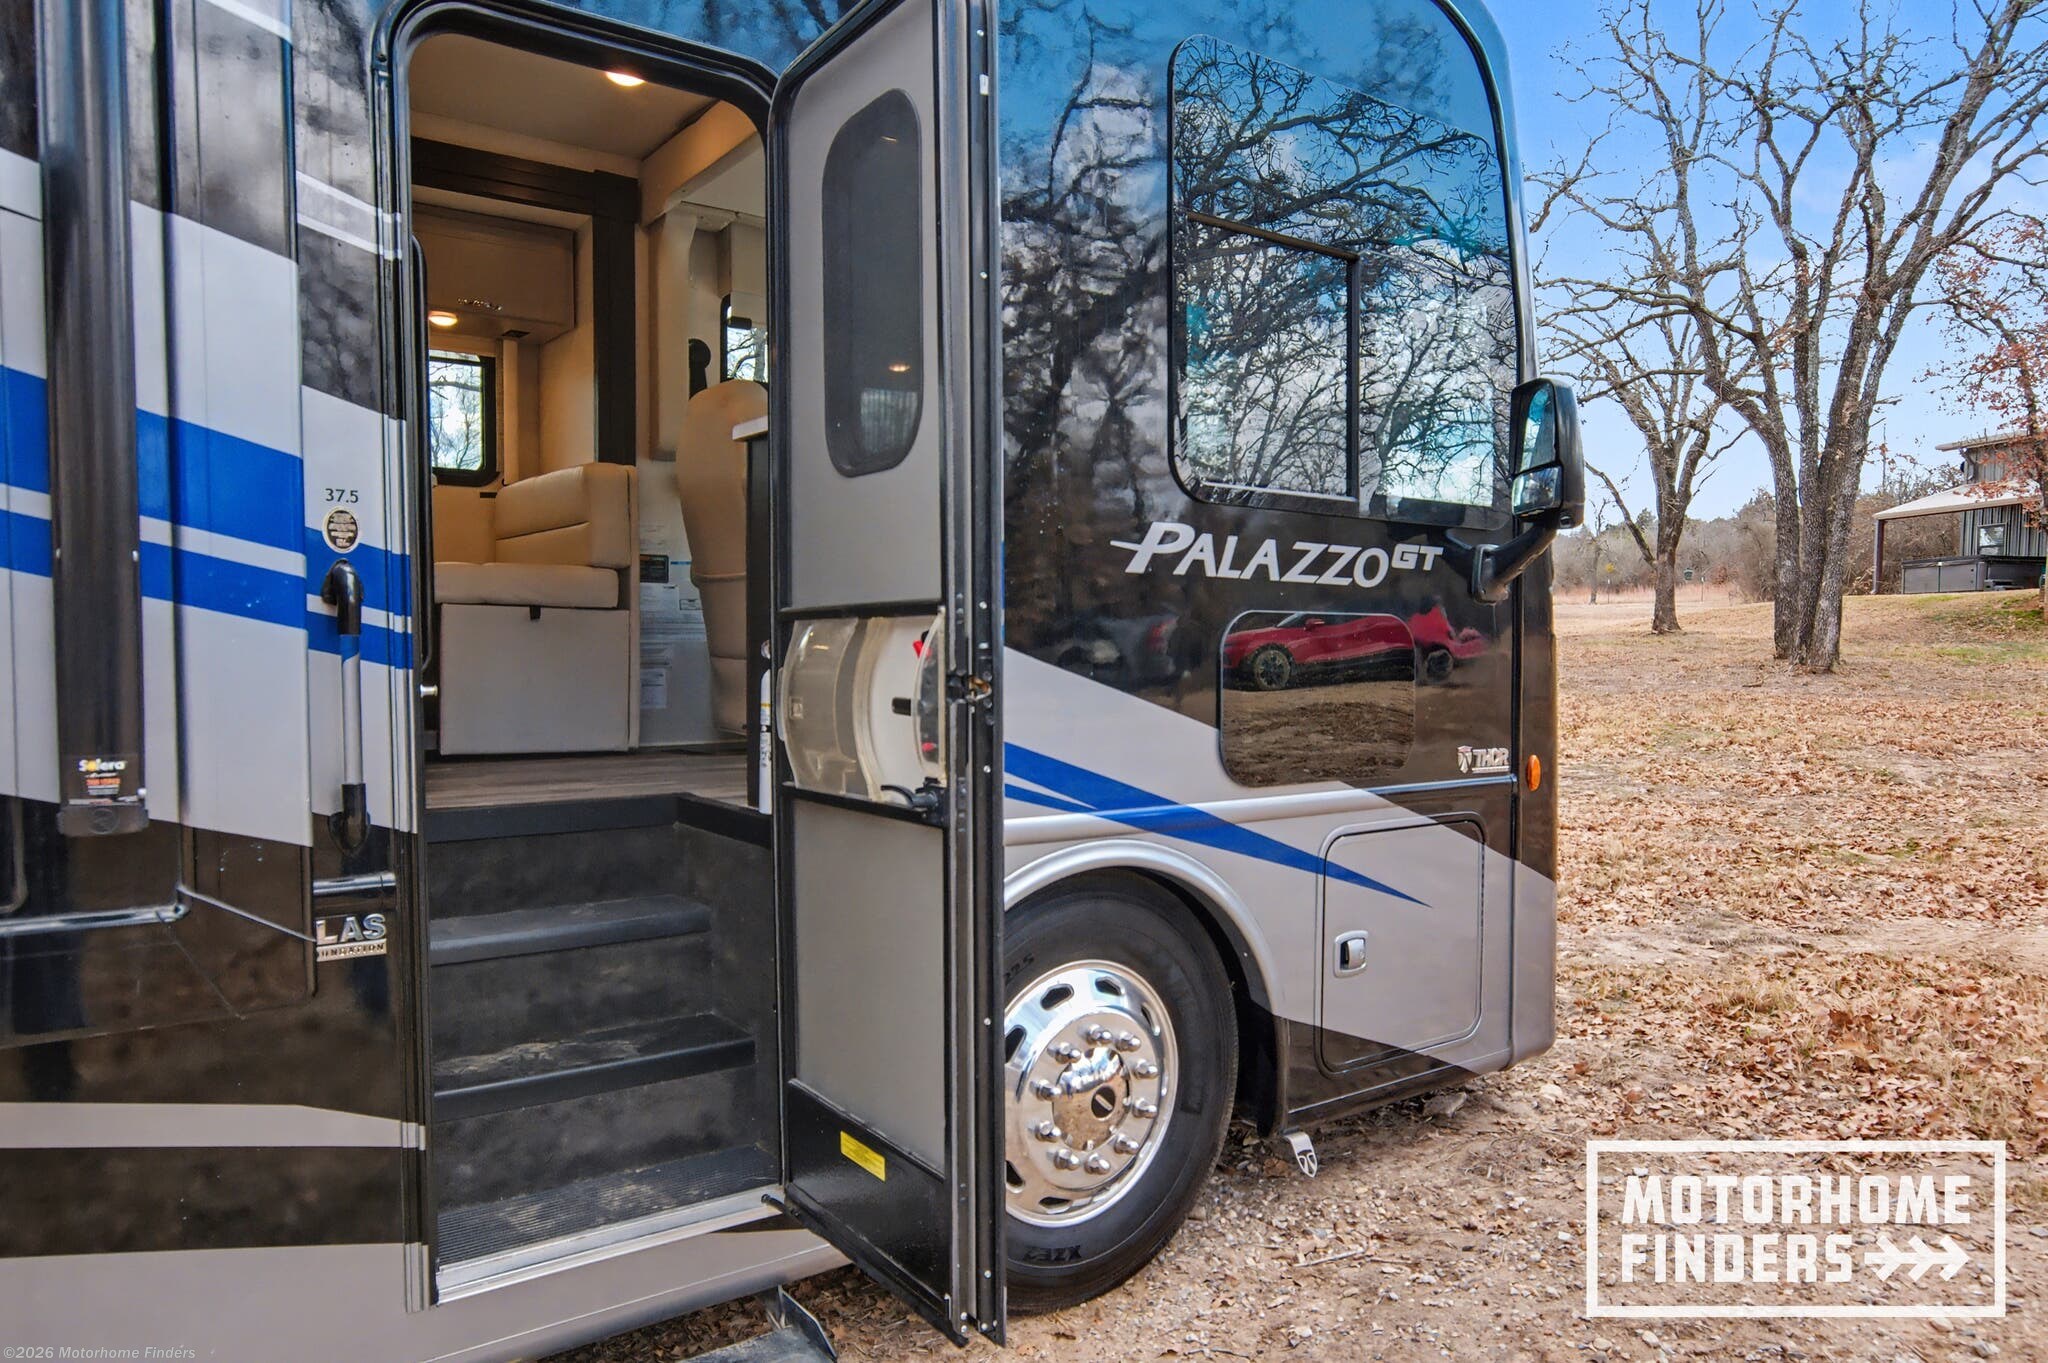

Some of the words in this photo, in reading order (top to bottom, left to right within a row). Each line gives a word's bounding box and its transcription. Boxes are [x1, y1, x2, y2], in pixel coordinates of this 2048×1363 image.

[325, 488, 359, 504] 37.5
[1110, 521, 1390, 588] PALAZZO
[1391, 543, 1443, 571] GT
[79, 758, 127, 772] Solera
[1472, 747, 1510, 767] THOR
